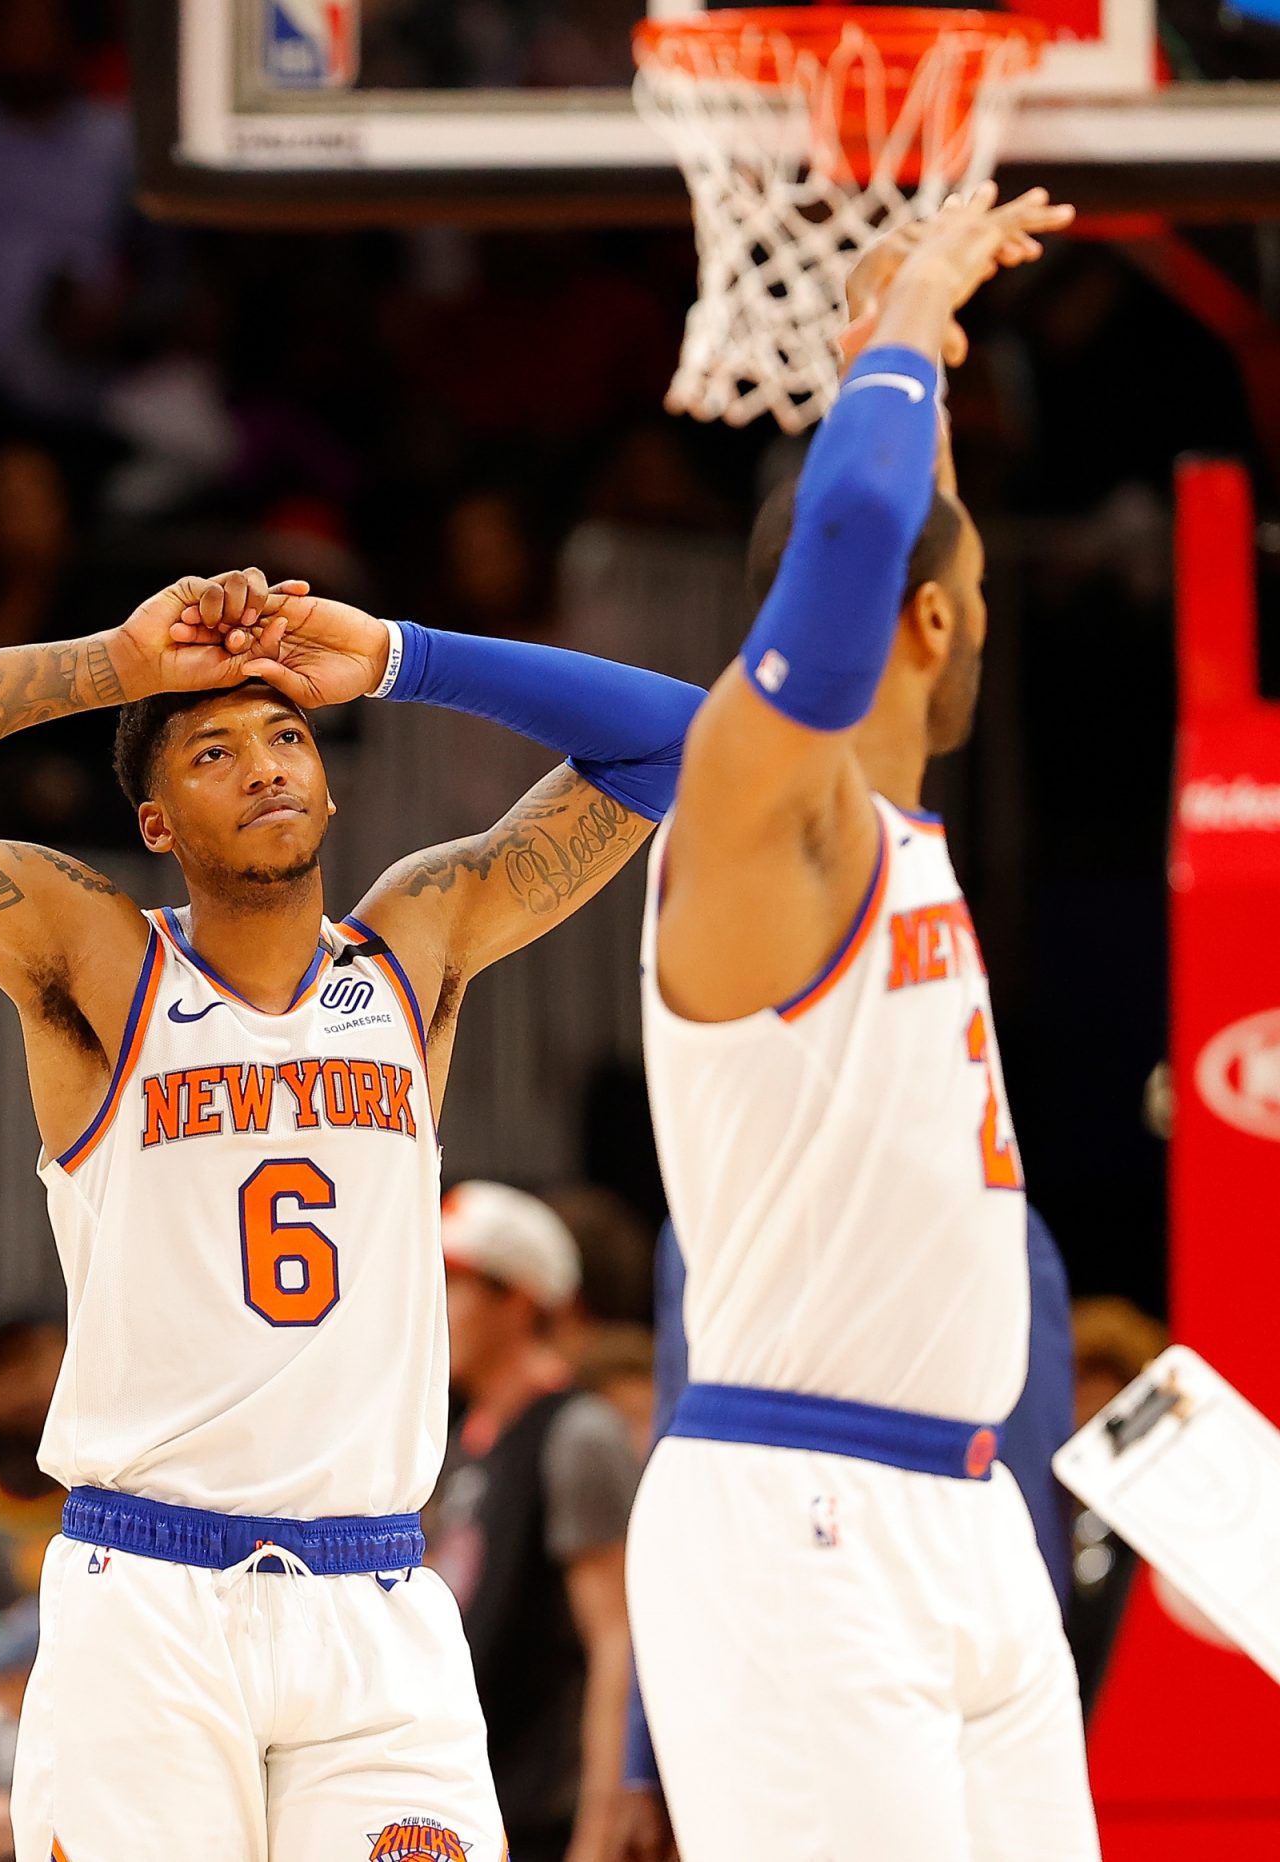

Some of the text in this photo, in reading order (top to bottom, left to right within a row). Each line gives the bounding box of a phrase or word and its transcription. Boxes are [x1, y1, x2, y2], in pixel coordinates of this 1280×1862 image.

[389, 649, 401, 677] 54:17
[506, 796, 631, 914] Blesse
[324, 1013, 392, 1034] SQUARESPACE
[141, 1057, 417, 1150] NEW YORK
[238, 1157, 341, 1327] 6
[369, 1822, 467, 1862] KNICKS
[401, 1816, 442, 1829] NEW YORK
